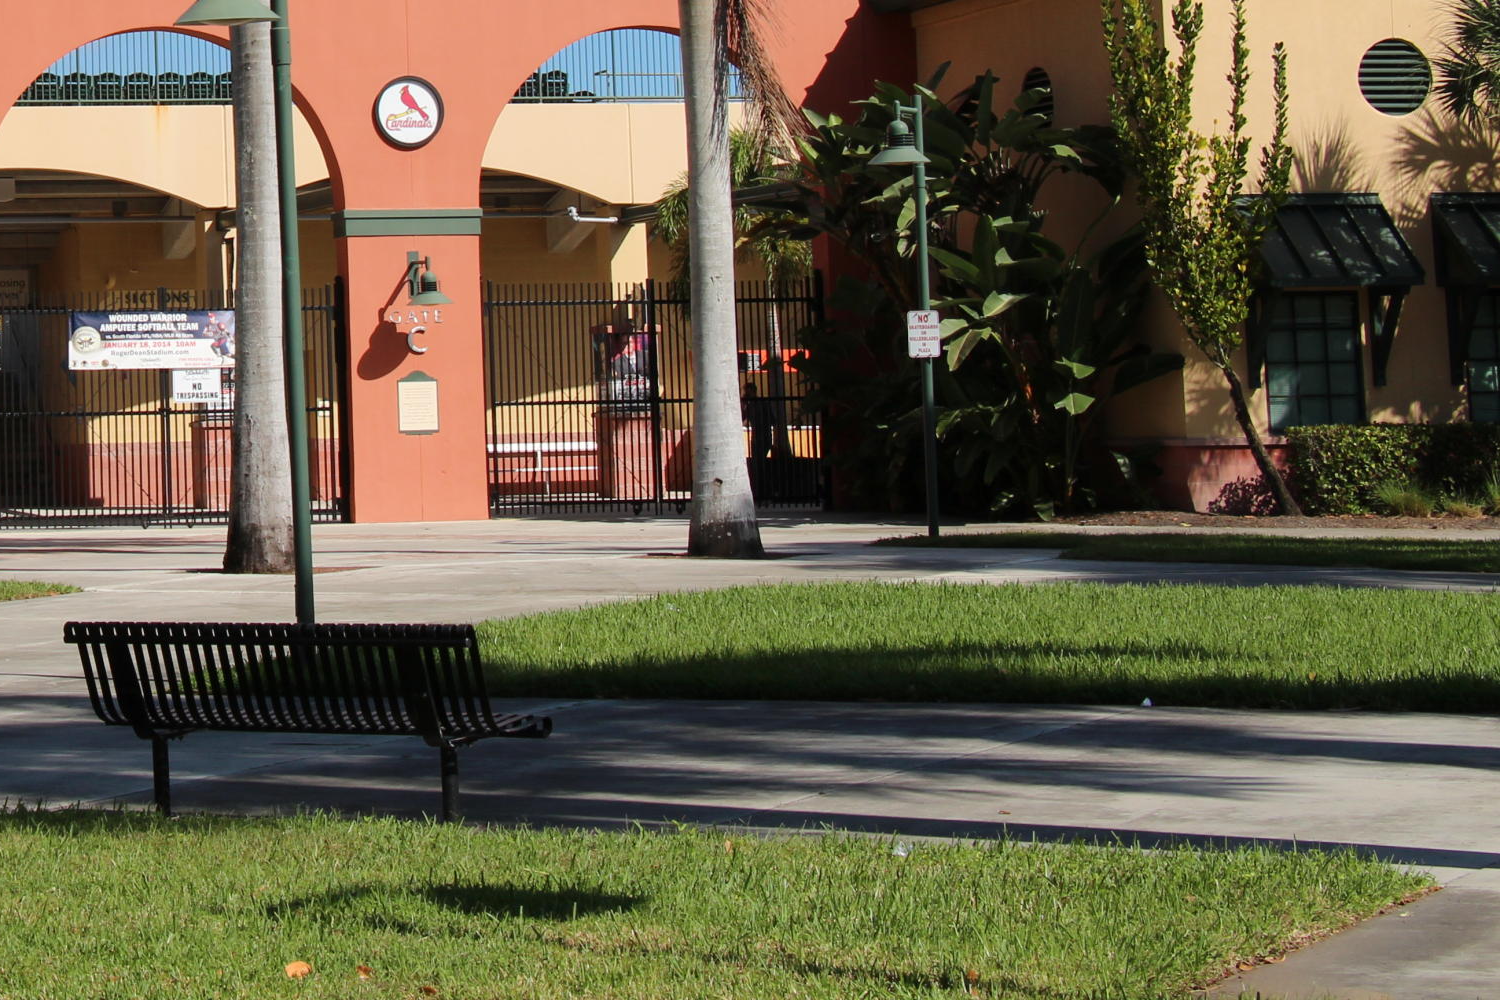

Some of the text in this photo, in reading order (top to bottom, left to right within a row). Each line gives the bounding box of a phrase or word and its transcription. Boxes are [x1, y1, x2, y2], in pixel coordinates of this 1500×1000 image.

[386, 114, 434, 131] Cardinals
[125, 291, 190, 304] SECTONS
[108, 313, 187, 322] WOUNDED WARRIOR
[389, 309, 444, 324] GATE
[917, 314, 928, 323] NO
[100, 322, 199, 332] AMPUTEE SOFTBALL TEAM
[407, 326, 429, 353] C
[103, 341, 137, 349] JANUARY
[192, 382, 202, 390] NO
